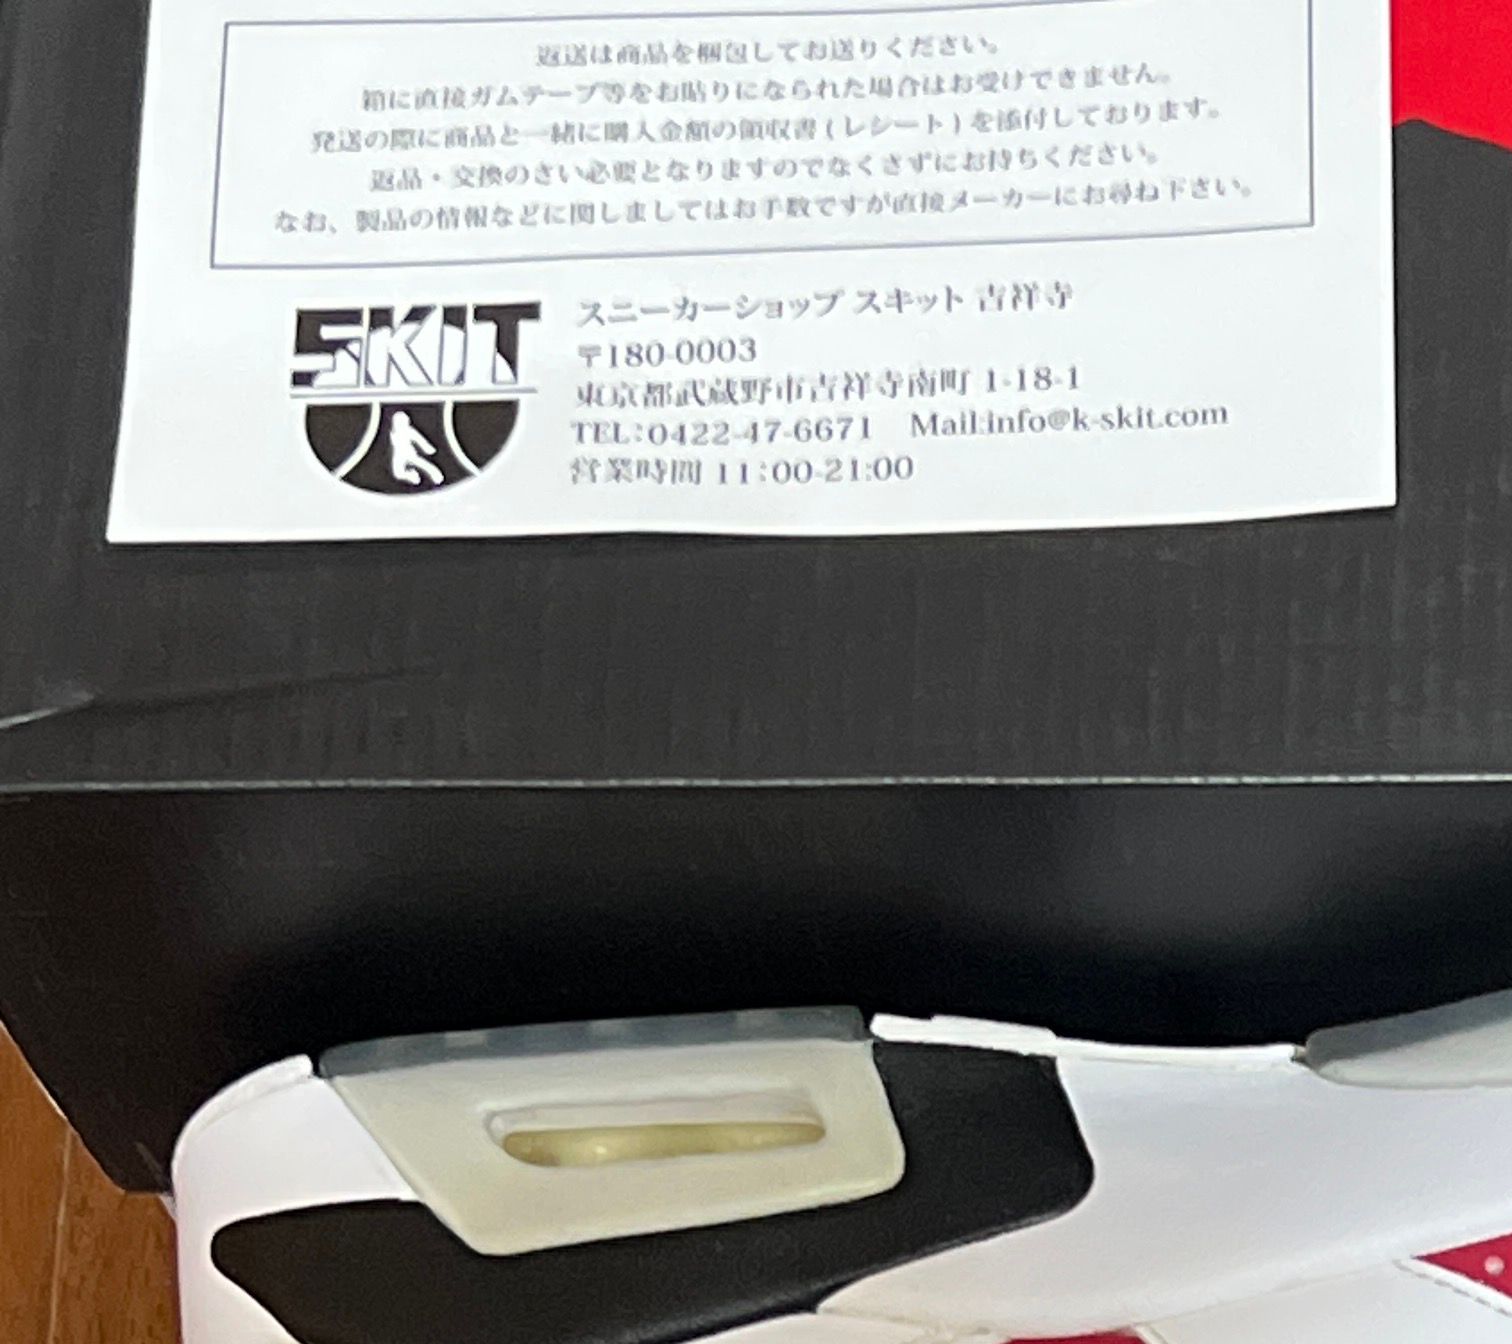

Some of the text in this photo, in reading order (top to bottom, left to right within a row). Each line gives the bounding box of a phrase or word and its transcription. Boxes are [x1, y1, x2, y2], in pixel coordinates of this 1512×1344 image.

[536, 34, 999, 68] 返送は商品を梱包してお送りください。
[579, 280, 1074, 327] スニーカーショップ スキット 吉祥寺
[289, 300, 542, 389] SKIT
[576, 366, 1081, 409] 東京都武蔵野市吉祥寺南町 1-18-1
[570, 415, 872, 446] TEL:0422-47-6671
[569, 454, 915, 486] 営業時間 11:00-21:00
